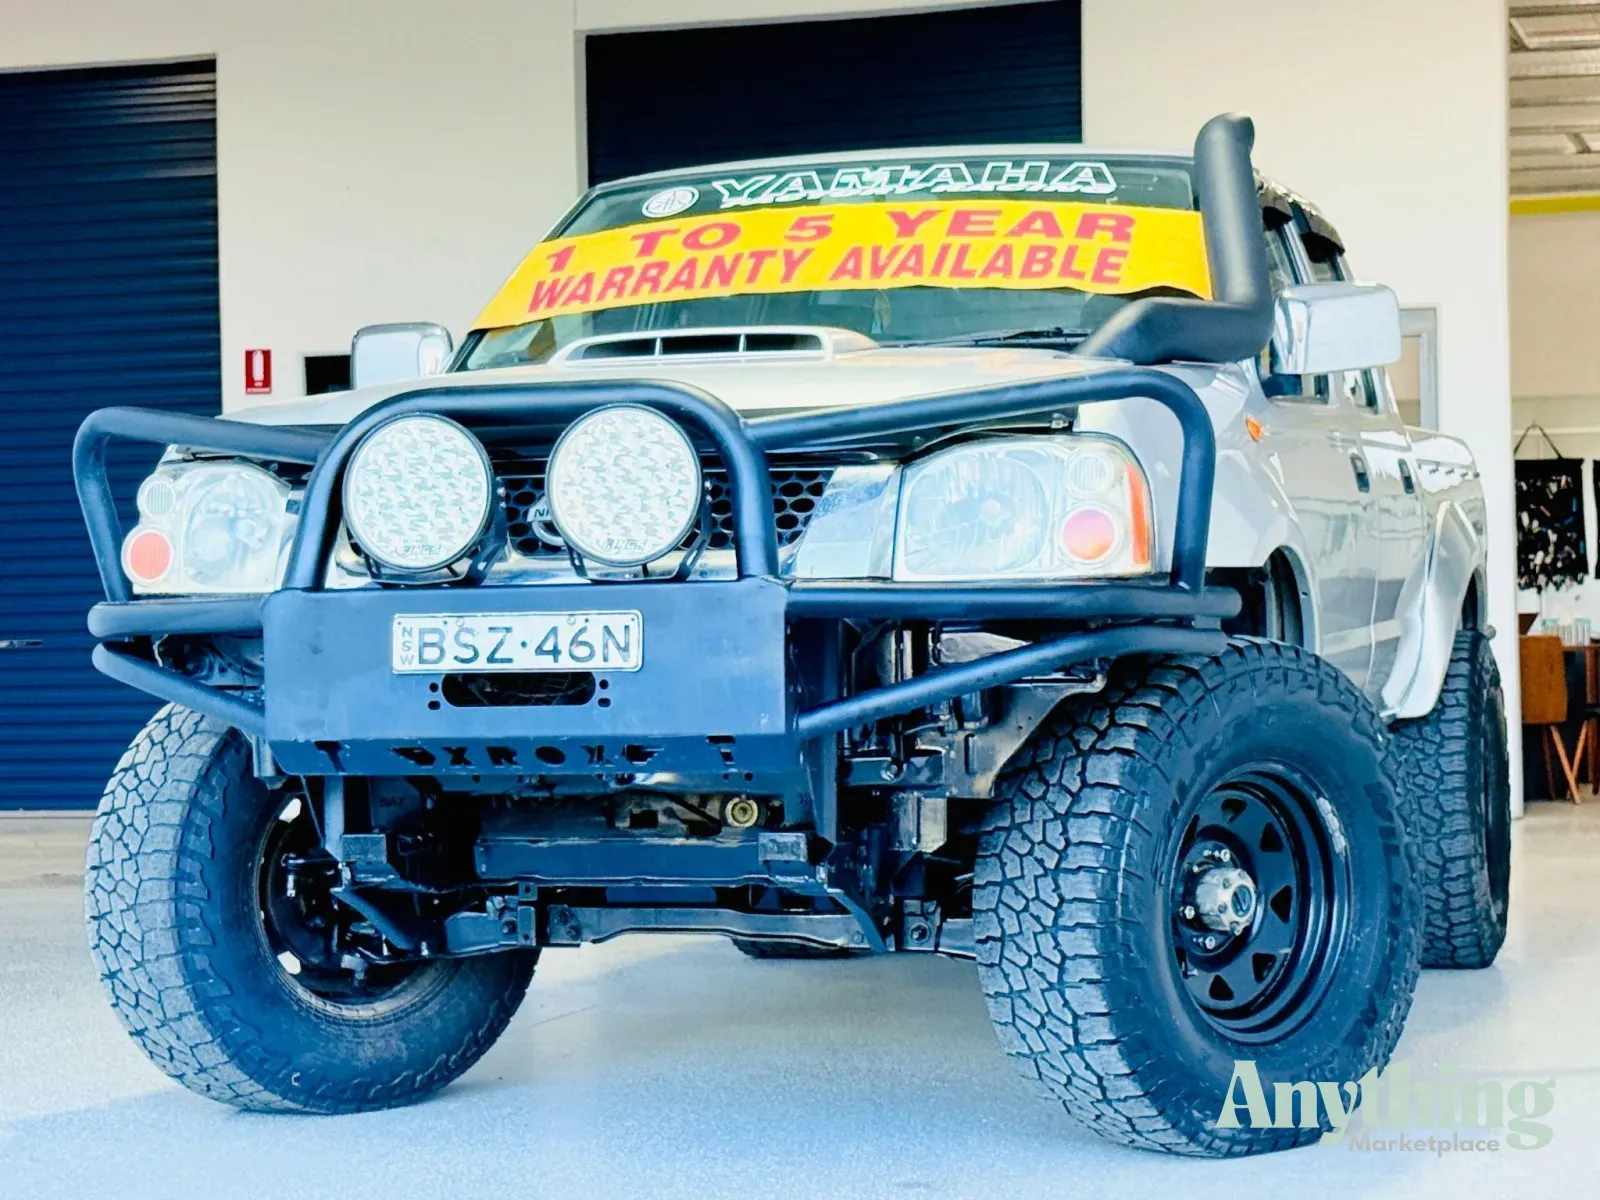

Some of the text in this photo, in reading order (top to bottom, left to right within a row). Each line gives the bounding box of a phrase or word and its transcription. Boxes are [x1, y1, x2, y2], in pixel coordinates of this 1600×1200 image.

[711, 161, 1119, 209] YAMAHA
[546, 209, 1137, 273] 1 TO 5 YEAR
[527, 243, 1130, 313] WARRANTY AVAILABLE
[400, 626, 416, 667] NSW
